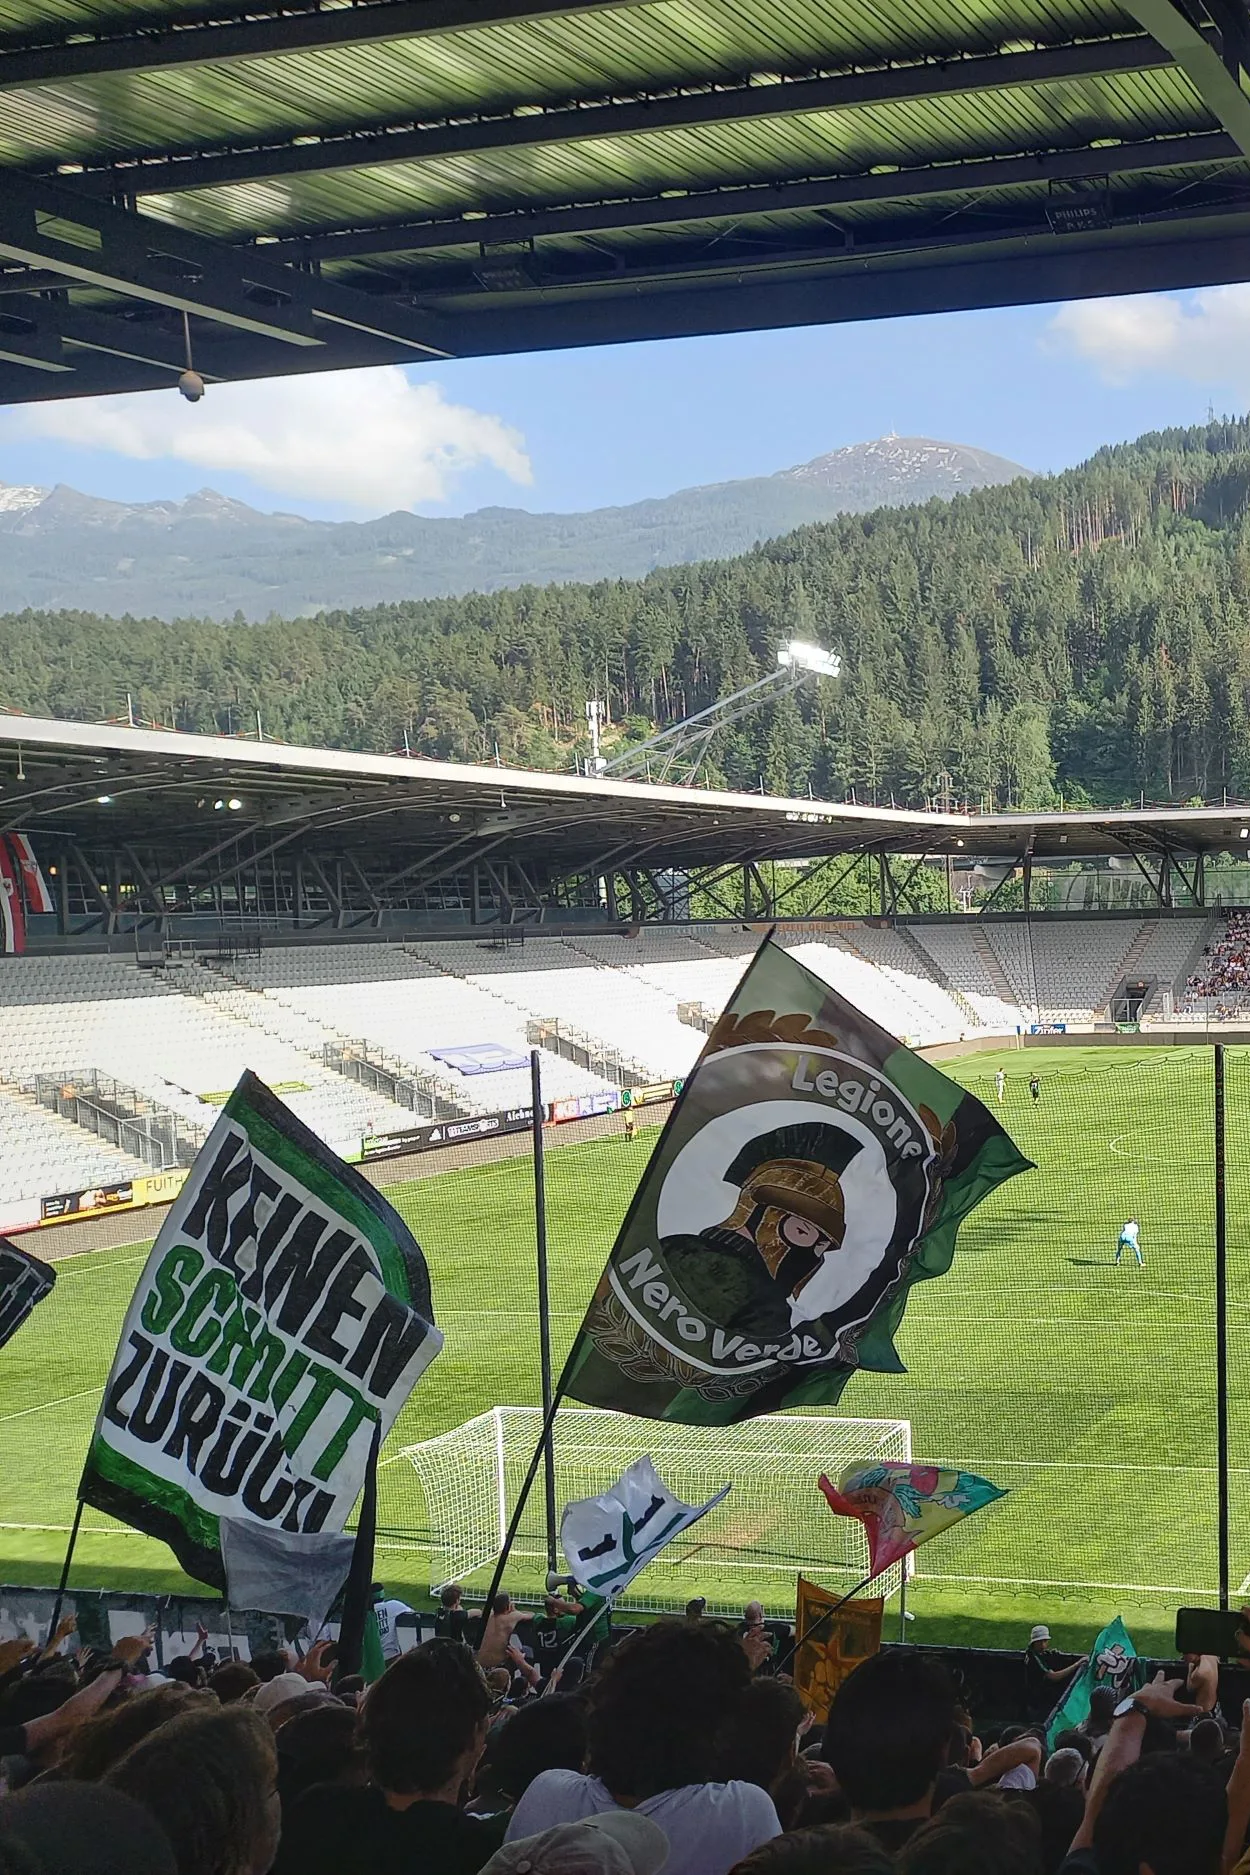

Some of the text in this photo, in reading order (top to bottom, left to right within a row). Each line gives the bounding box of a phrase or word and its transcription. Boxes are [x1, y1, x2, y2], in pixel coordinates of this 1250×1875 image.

[1055, 207, 1097, 220] PHILIPS
[791, 1054, 923, 1160] Legione
[181, 1130, 429, 1400] KEINEN
[619, 1247, 822, 1363] Nero Verde
[537, 1629, 558, 1648] 12
